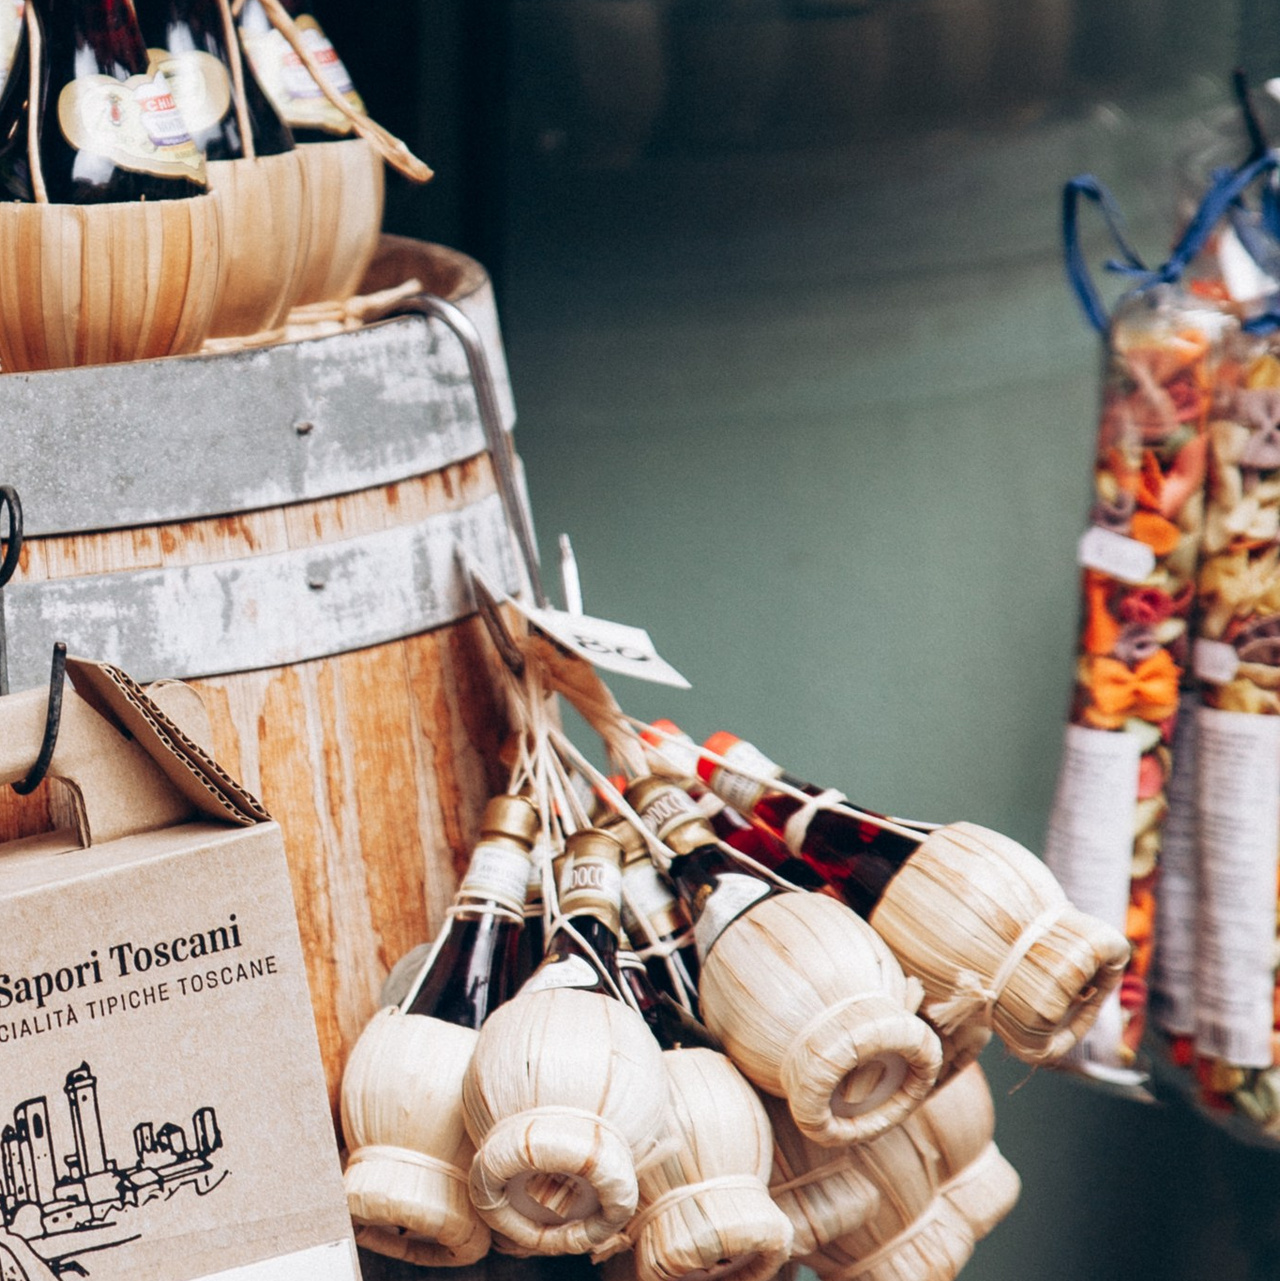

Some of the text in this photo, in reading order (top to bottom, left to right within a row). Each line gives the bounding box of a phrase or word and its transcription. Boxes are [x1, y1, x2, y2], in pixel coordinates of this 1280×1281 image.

[109, 913, 243, 979] Toscani
[86, 982, 171, 1019] TIPICHE
[180, 954, 278, 996] TOSCANE
